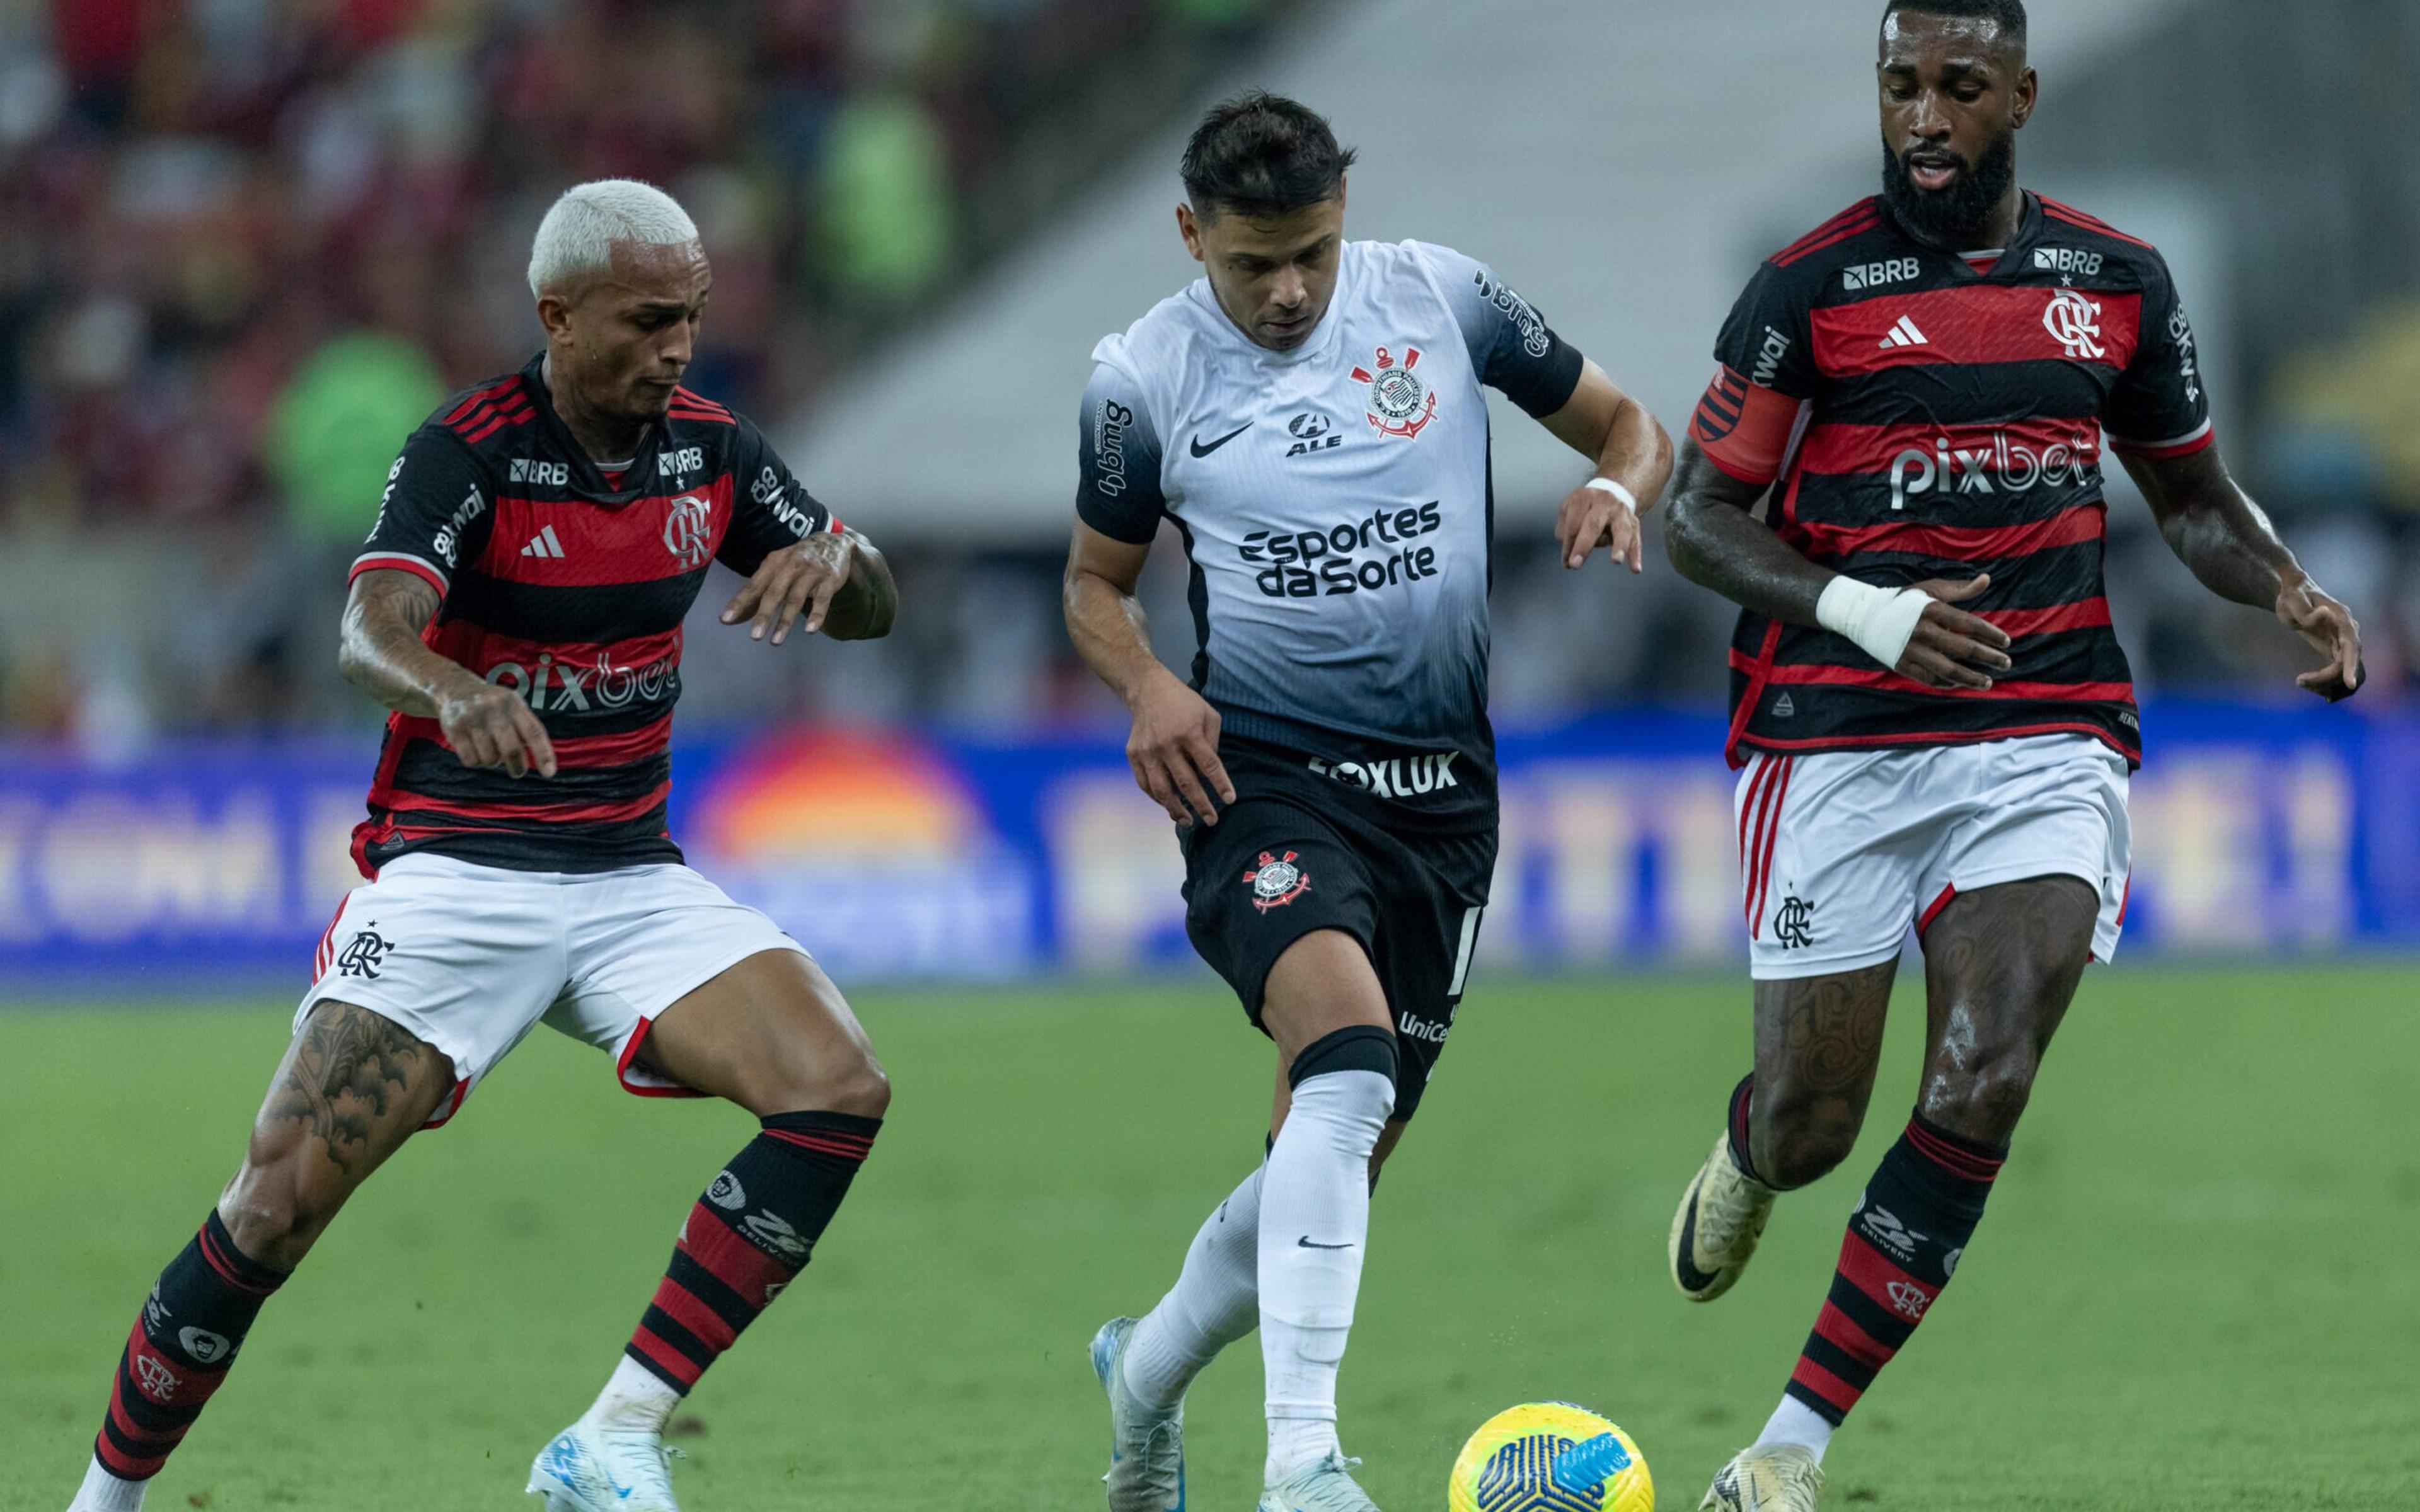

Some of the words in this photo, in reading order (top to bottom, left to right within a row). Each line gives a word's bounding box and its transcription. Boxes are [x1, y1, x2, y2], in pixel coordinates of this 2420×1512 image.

[1868, 256, 1920, 286] BRB
[2057, 249, 2104, 276] BRB
[1097, 398, 1134, 475] bmg
[1285, 435, 1342, 458] ALE
[528, 461, 570, 486] BRB
[676, 447, 704, 474] BRB
[1890, 431, 2093, 510] pixbet
[1238, 500, 1441, 570] Esportes
